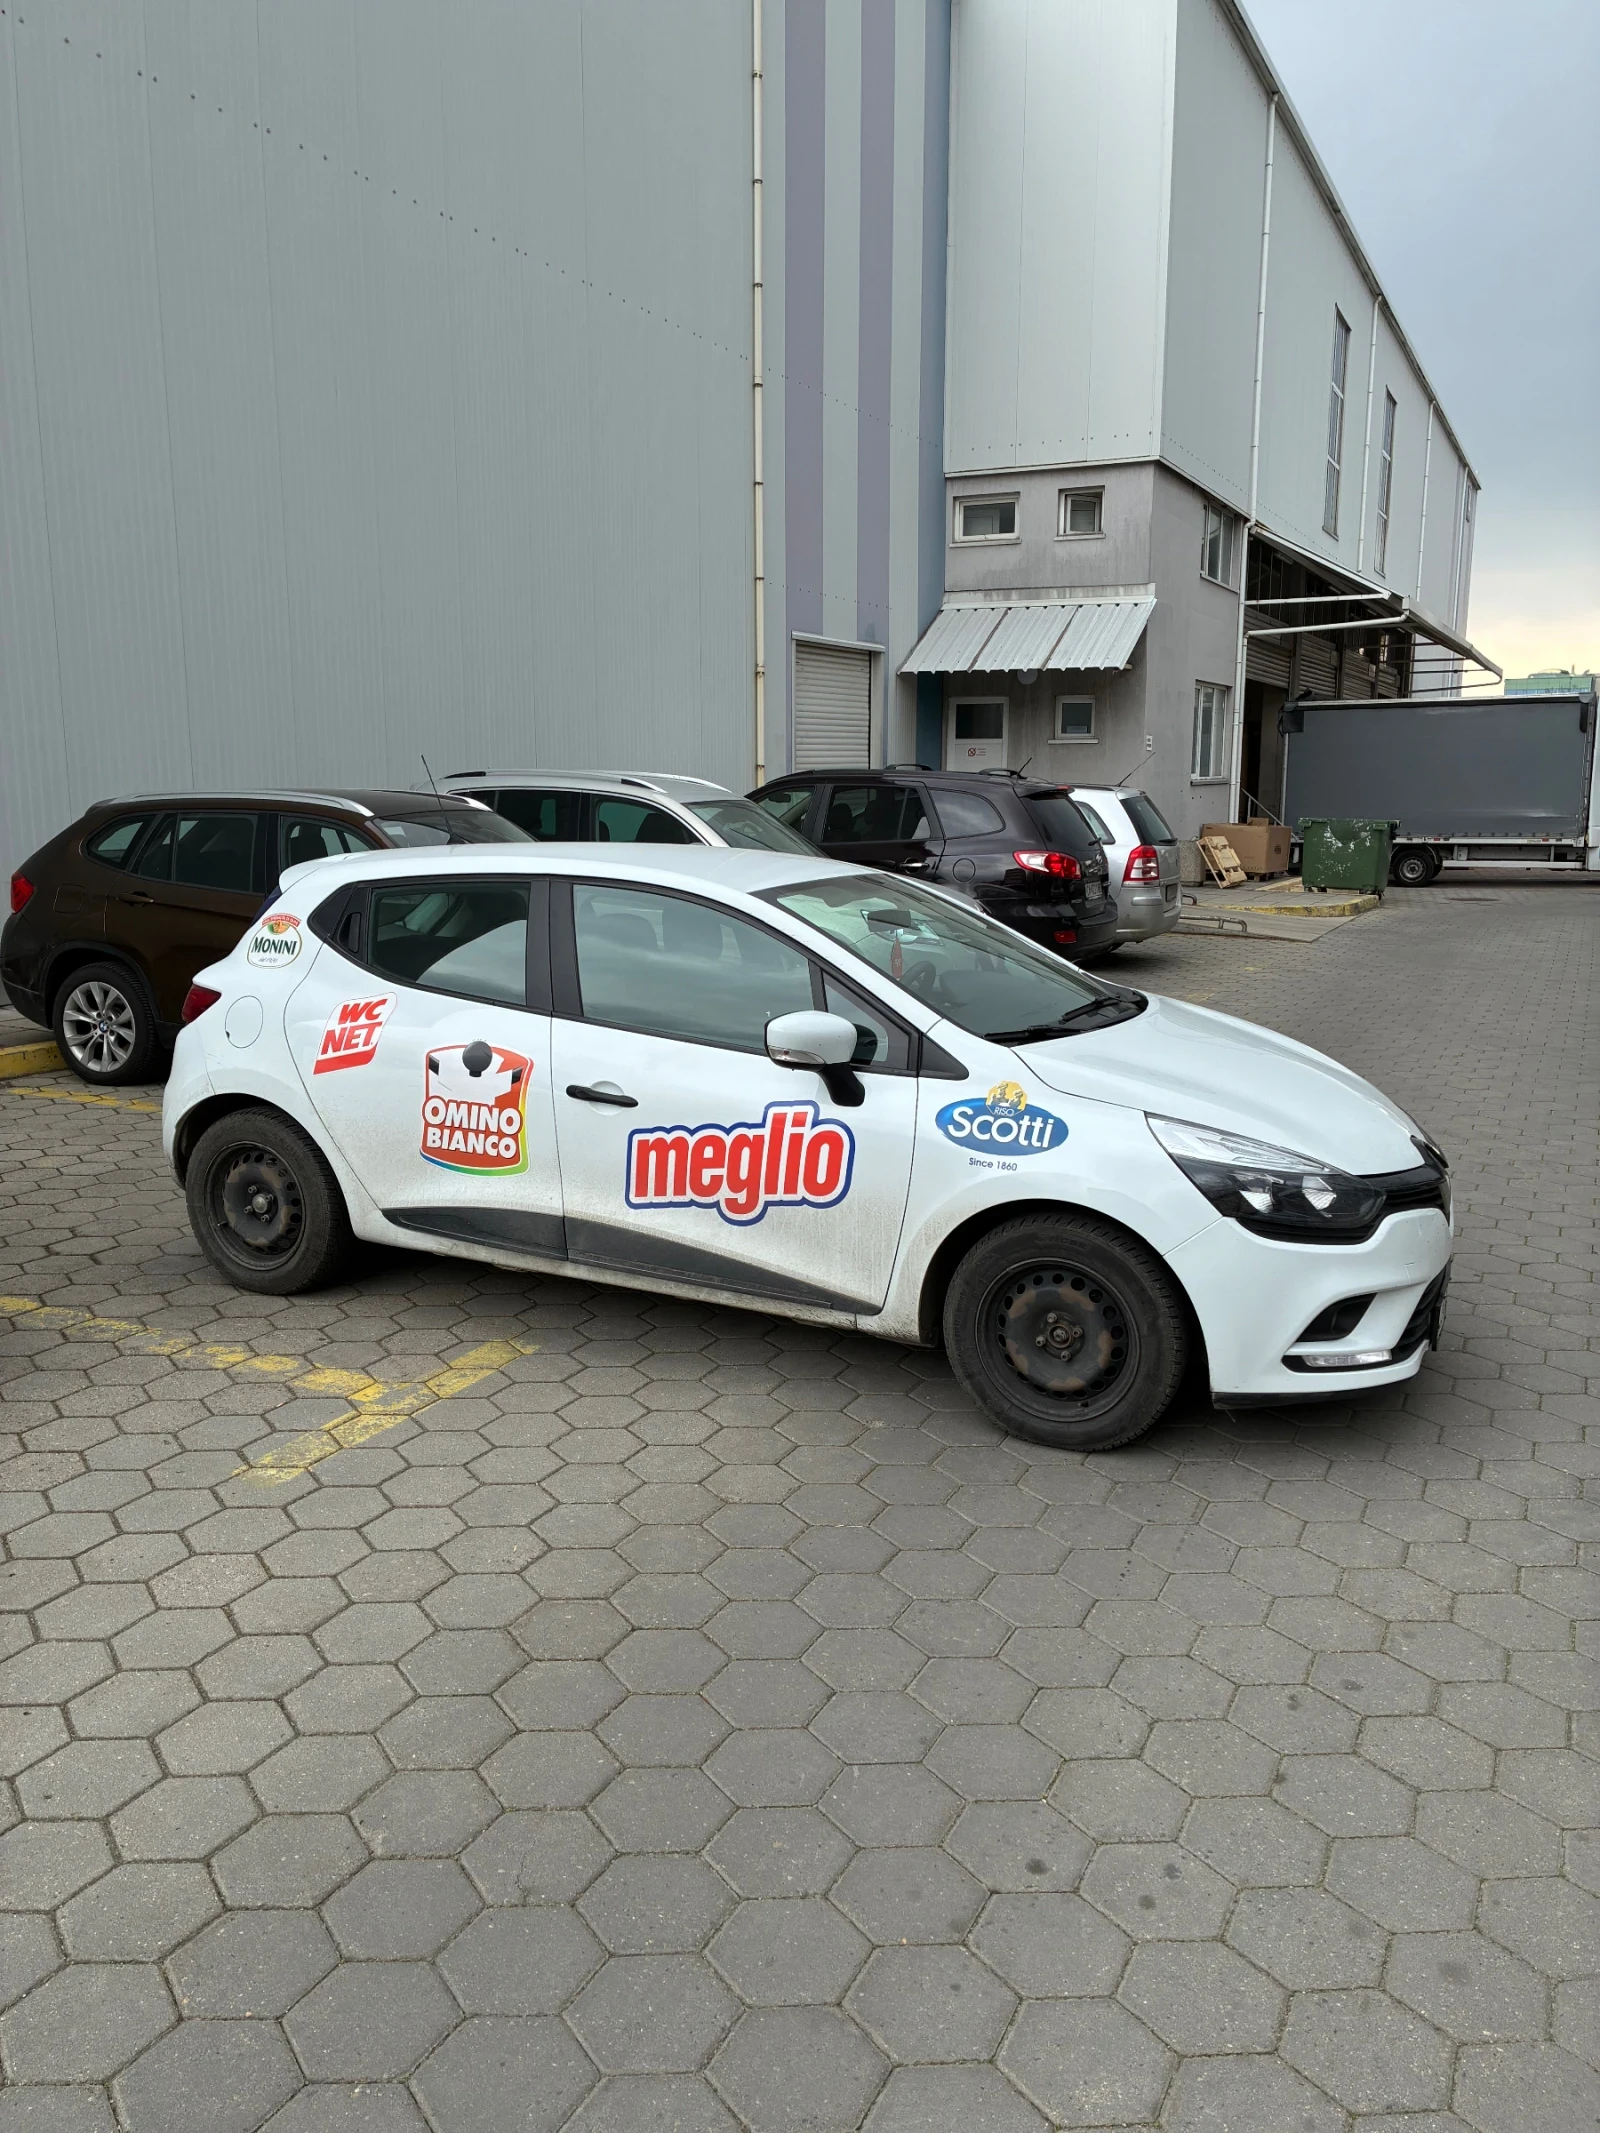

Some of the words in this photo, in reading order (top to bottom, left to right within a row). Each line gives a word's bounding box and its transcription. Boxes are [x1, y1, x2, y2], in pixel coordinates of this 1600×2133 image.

[251, 936, 297, 955] MONINI
[338, 998, 387, 1024] WC
[321, 1022, 382, 1055] NET
[424, 1098, 521, 1135] OMINO
[994, 1106, 1015, 1116] RISO
[426, 1127, 517, 1158] BIANCO
[947, 1106, 1055, 1148] Scotti
[635, 1111, 845, 1214] meglio
[968, 1157, 993, 1168] Since
[996, 1161, 1018, 1171] 1860
